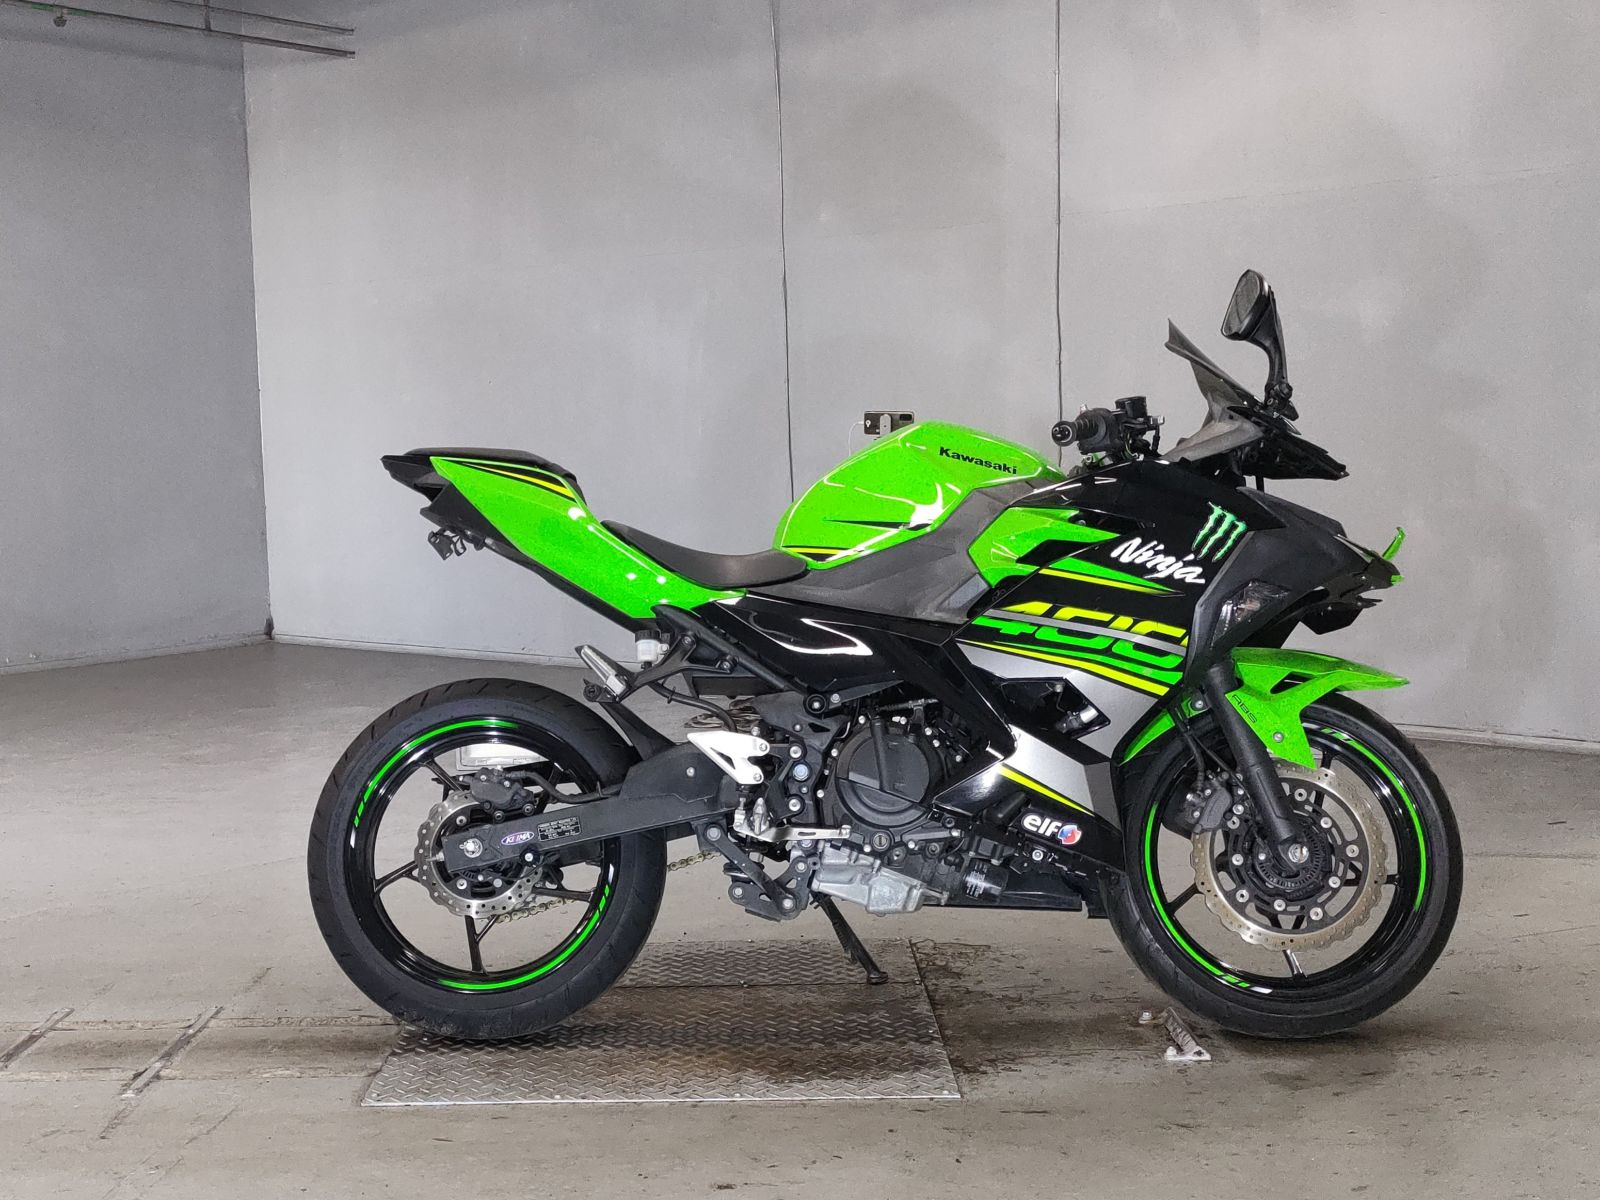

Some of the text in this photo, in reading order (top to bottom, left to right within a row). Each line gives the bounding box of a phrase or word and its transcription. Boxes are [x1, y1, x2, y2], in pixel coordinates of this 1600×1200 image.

[939, 446, 1017, 475] Kawasaki
[1110, 537, 1206, 584] Ninja
[1232, 694, 1258, 723] ABS
[1023, 814, 1062, 837] elf
